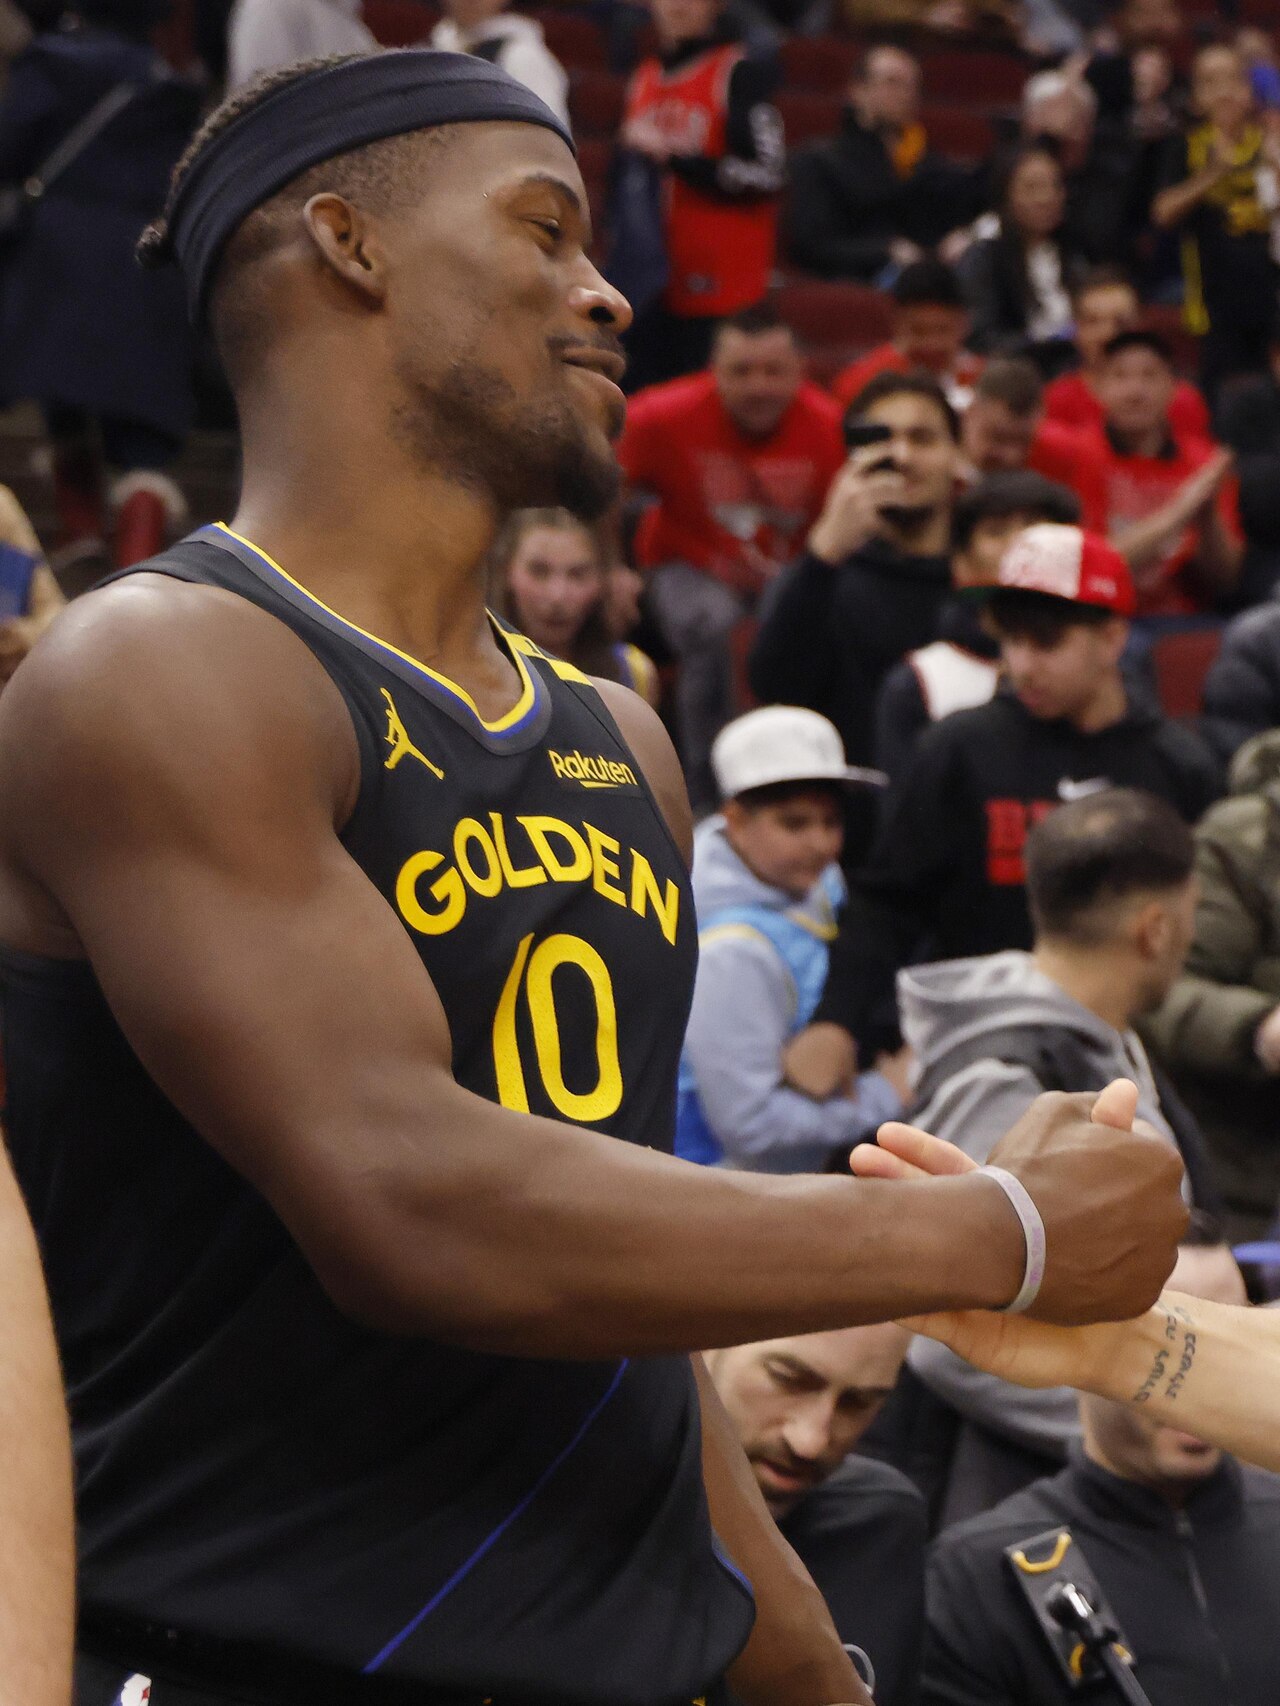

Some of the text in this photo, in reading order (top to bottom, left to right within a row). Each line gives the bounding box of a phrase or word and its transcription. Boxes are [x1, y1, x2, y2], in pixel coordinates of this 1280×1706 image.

[547, 749, 639, 787] Rakuten
[395, 811, 680, 947] GOLDEN
[492, 931, 624, 1122] 10
